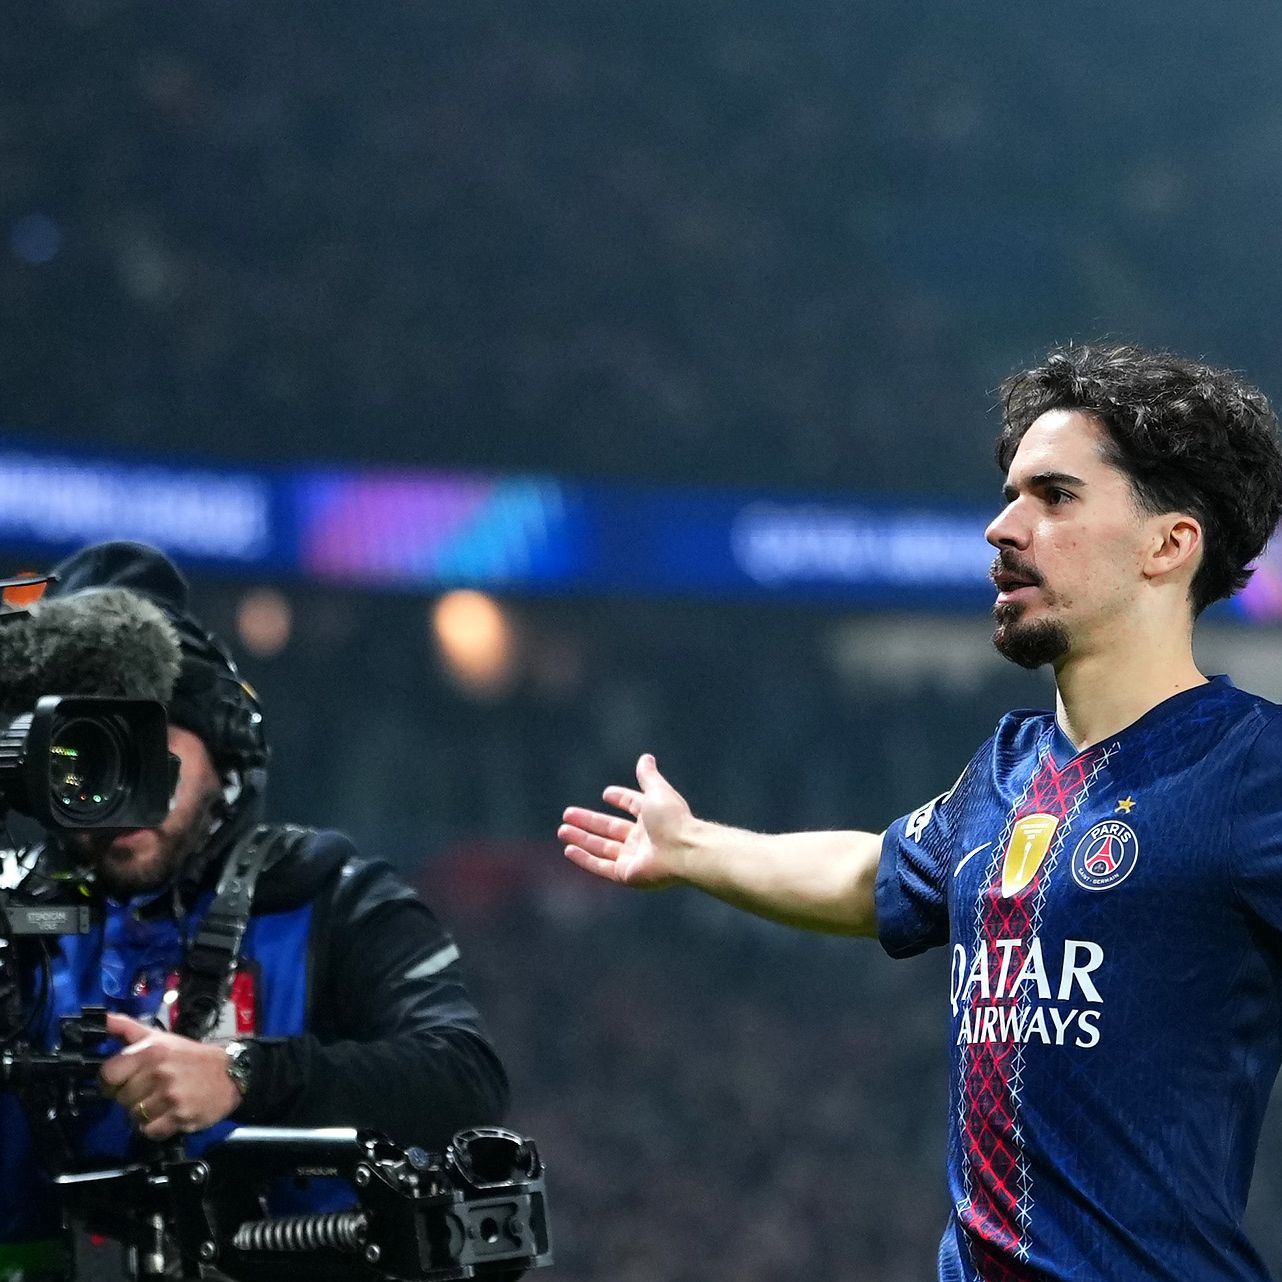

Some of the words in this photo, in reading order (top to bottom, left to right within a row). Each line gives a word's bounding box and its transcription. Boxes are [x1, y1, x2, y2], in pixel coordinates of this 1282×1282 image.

[1091, 824, 1132, 843] PARIS
[950, 937, 1104, 1017] QATAR
[956, 1006, 1101, 1048] AIRWAYS
